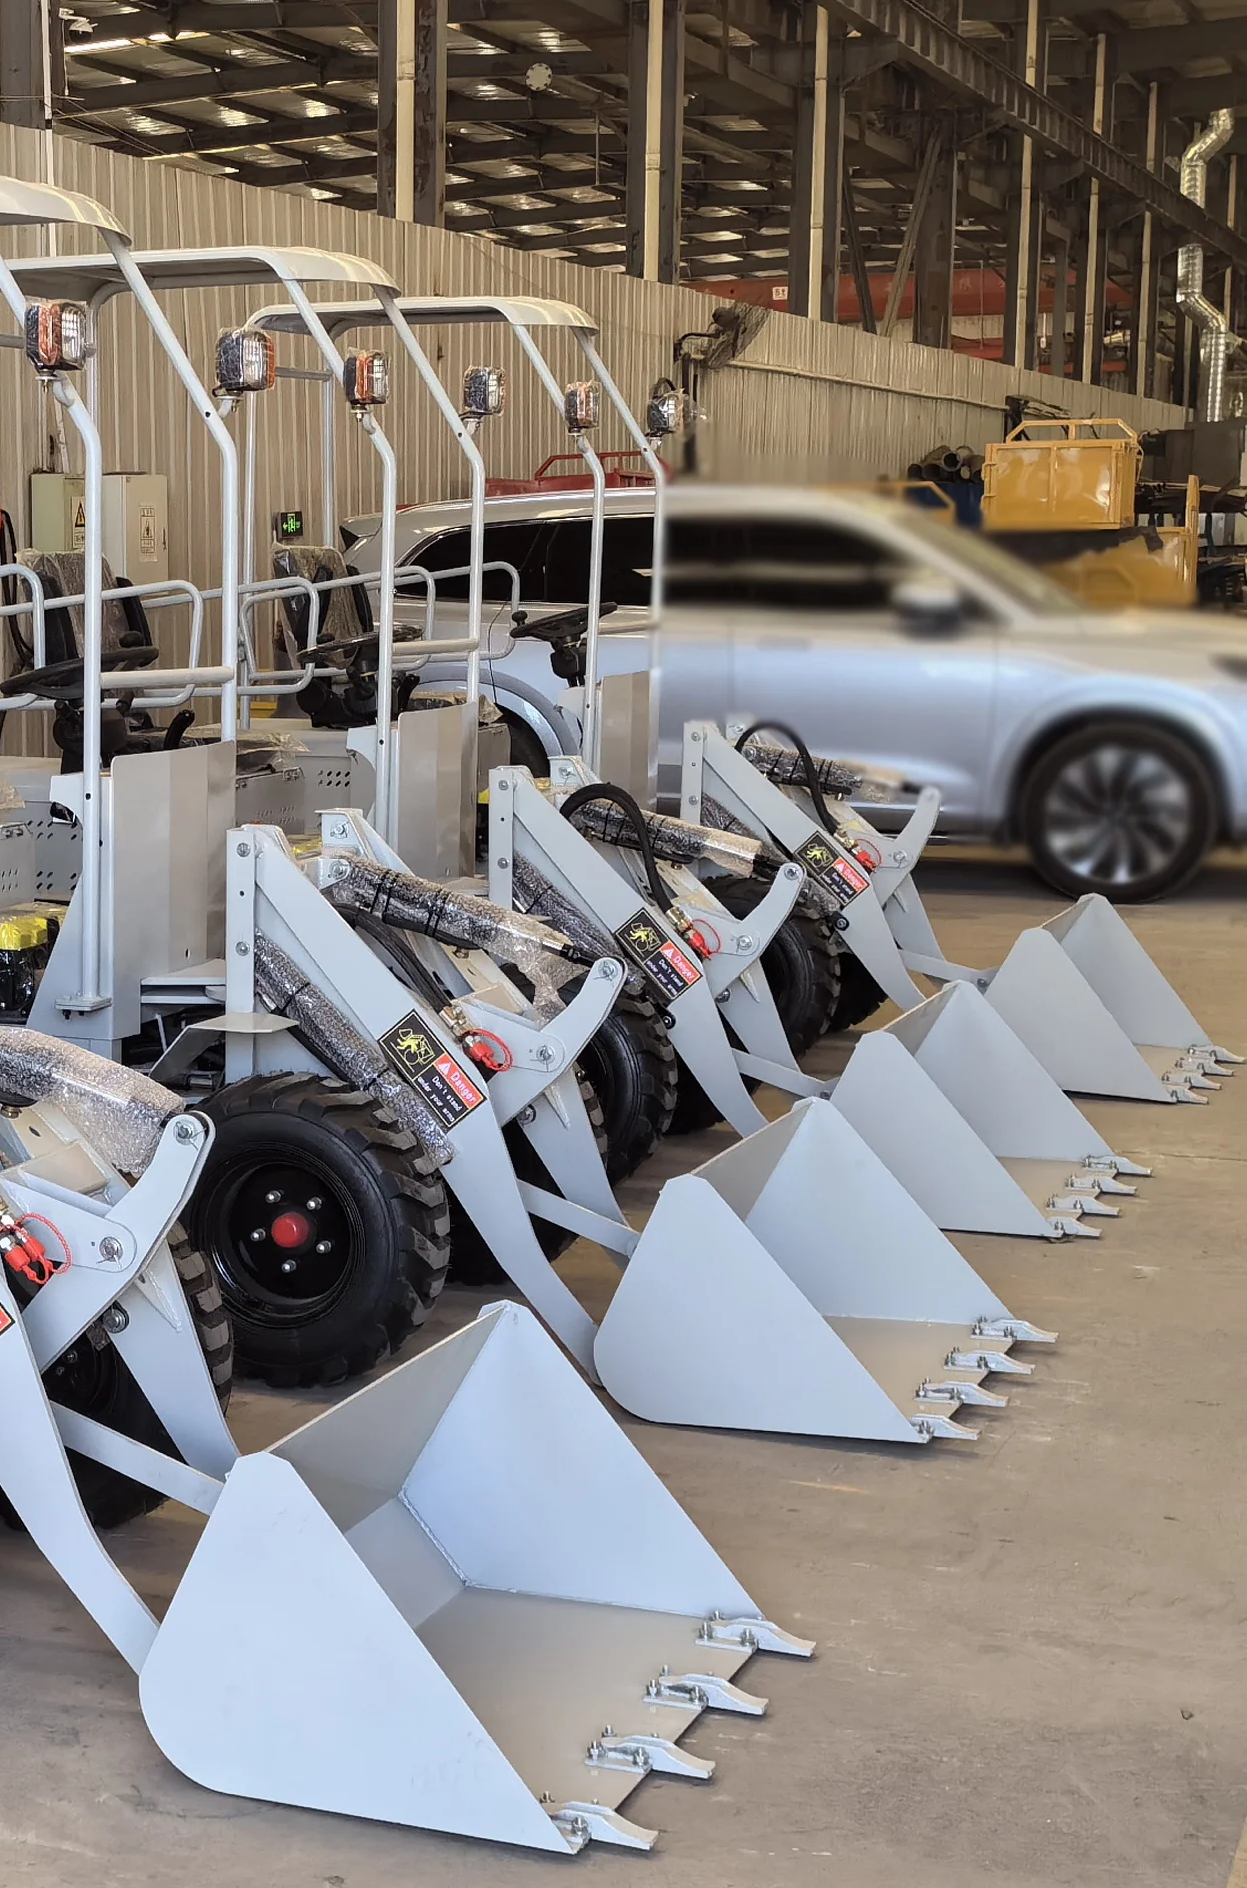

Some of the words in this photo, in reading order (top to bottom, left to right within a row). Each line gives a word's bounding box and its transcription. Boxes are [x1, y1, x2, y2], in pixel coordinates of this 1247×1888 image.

[430, 1093, 443, 1107] your
[432, 1075, 447, 1095] Don't
[447, 1093, 463, 1111] stand
[451, 1072, 476, 1102] Danger
